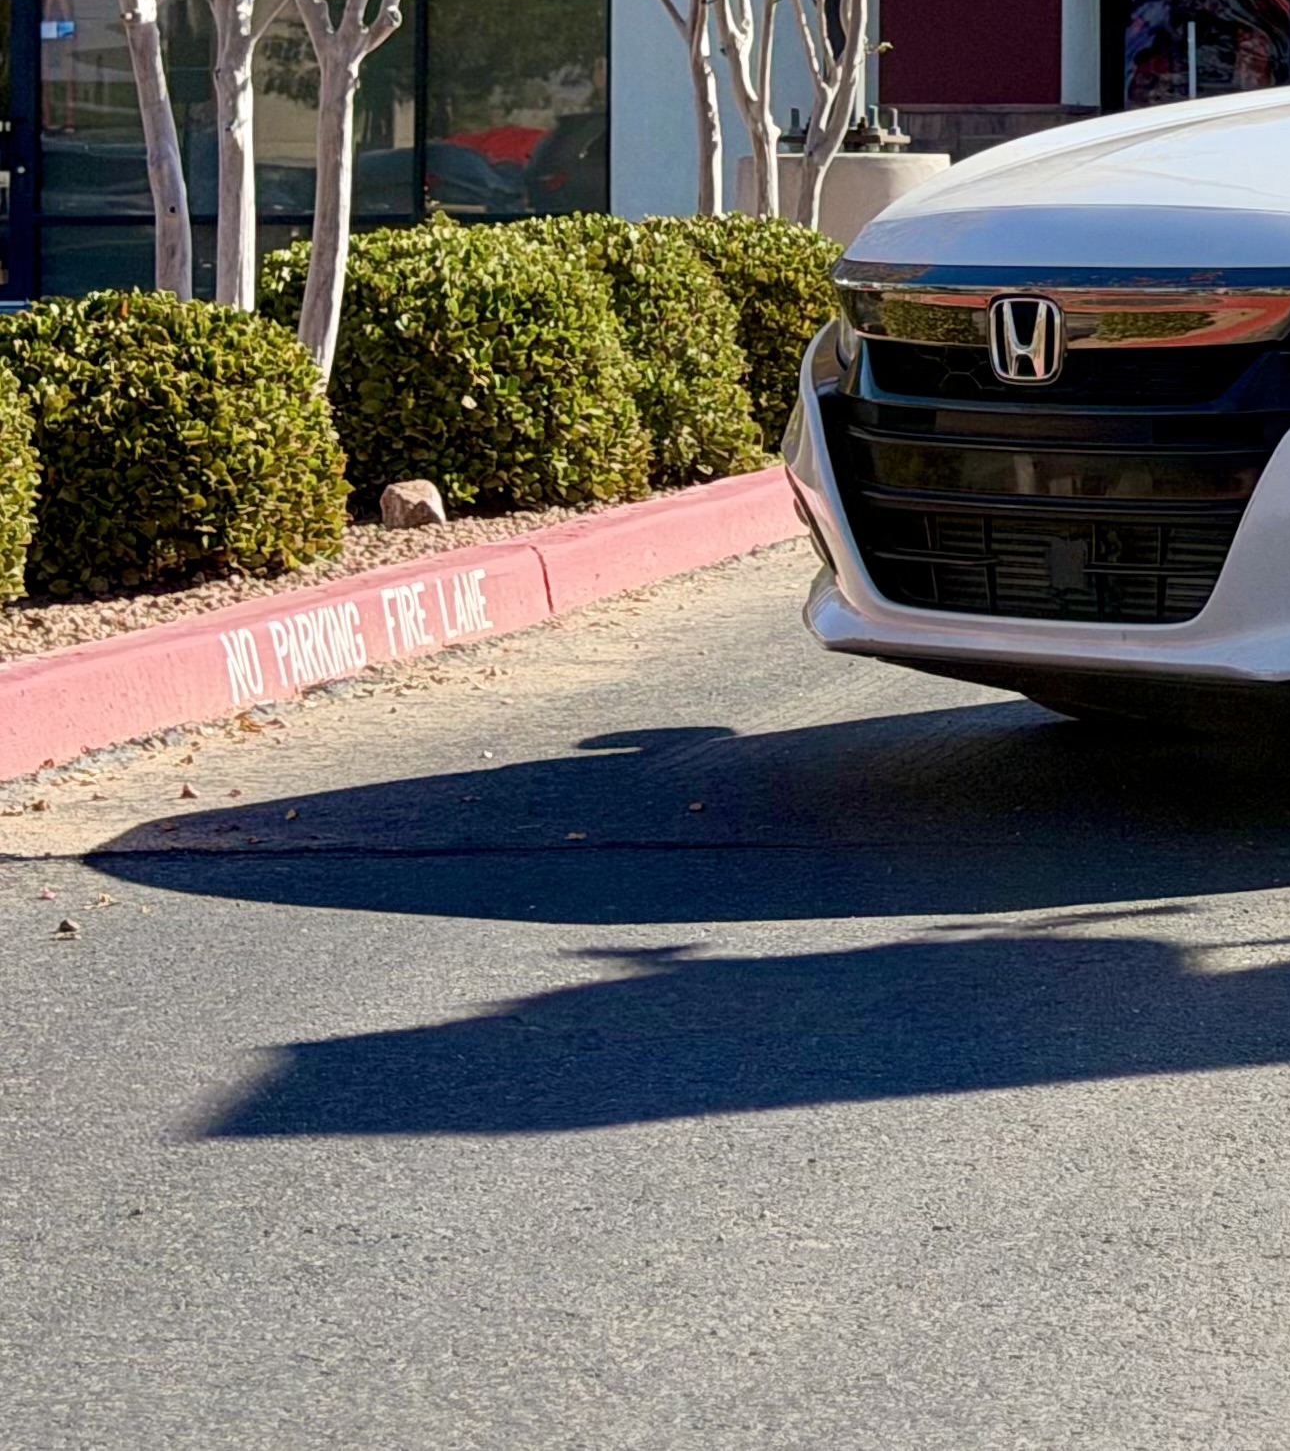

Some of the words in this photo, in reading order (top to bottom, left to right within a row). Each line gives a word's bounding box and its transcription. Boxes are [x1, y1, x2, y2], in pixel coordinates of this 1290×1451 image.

[219, 629, 263, 705] NO
[267, 600, 367, 688] PARKING
[380, 581, 434, 656] FIRE
[435, 568, 494, 640] LANE
